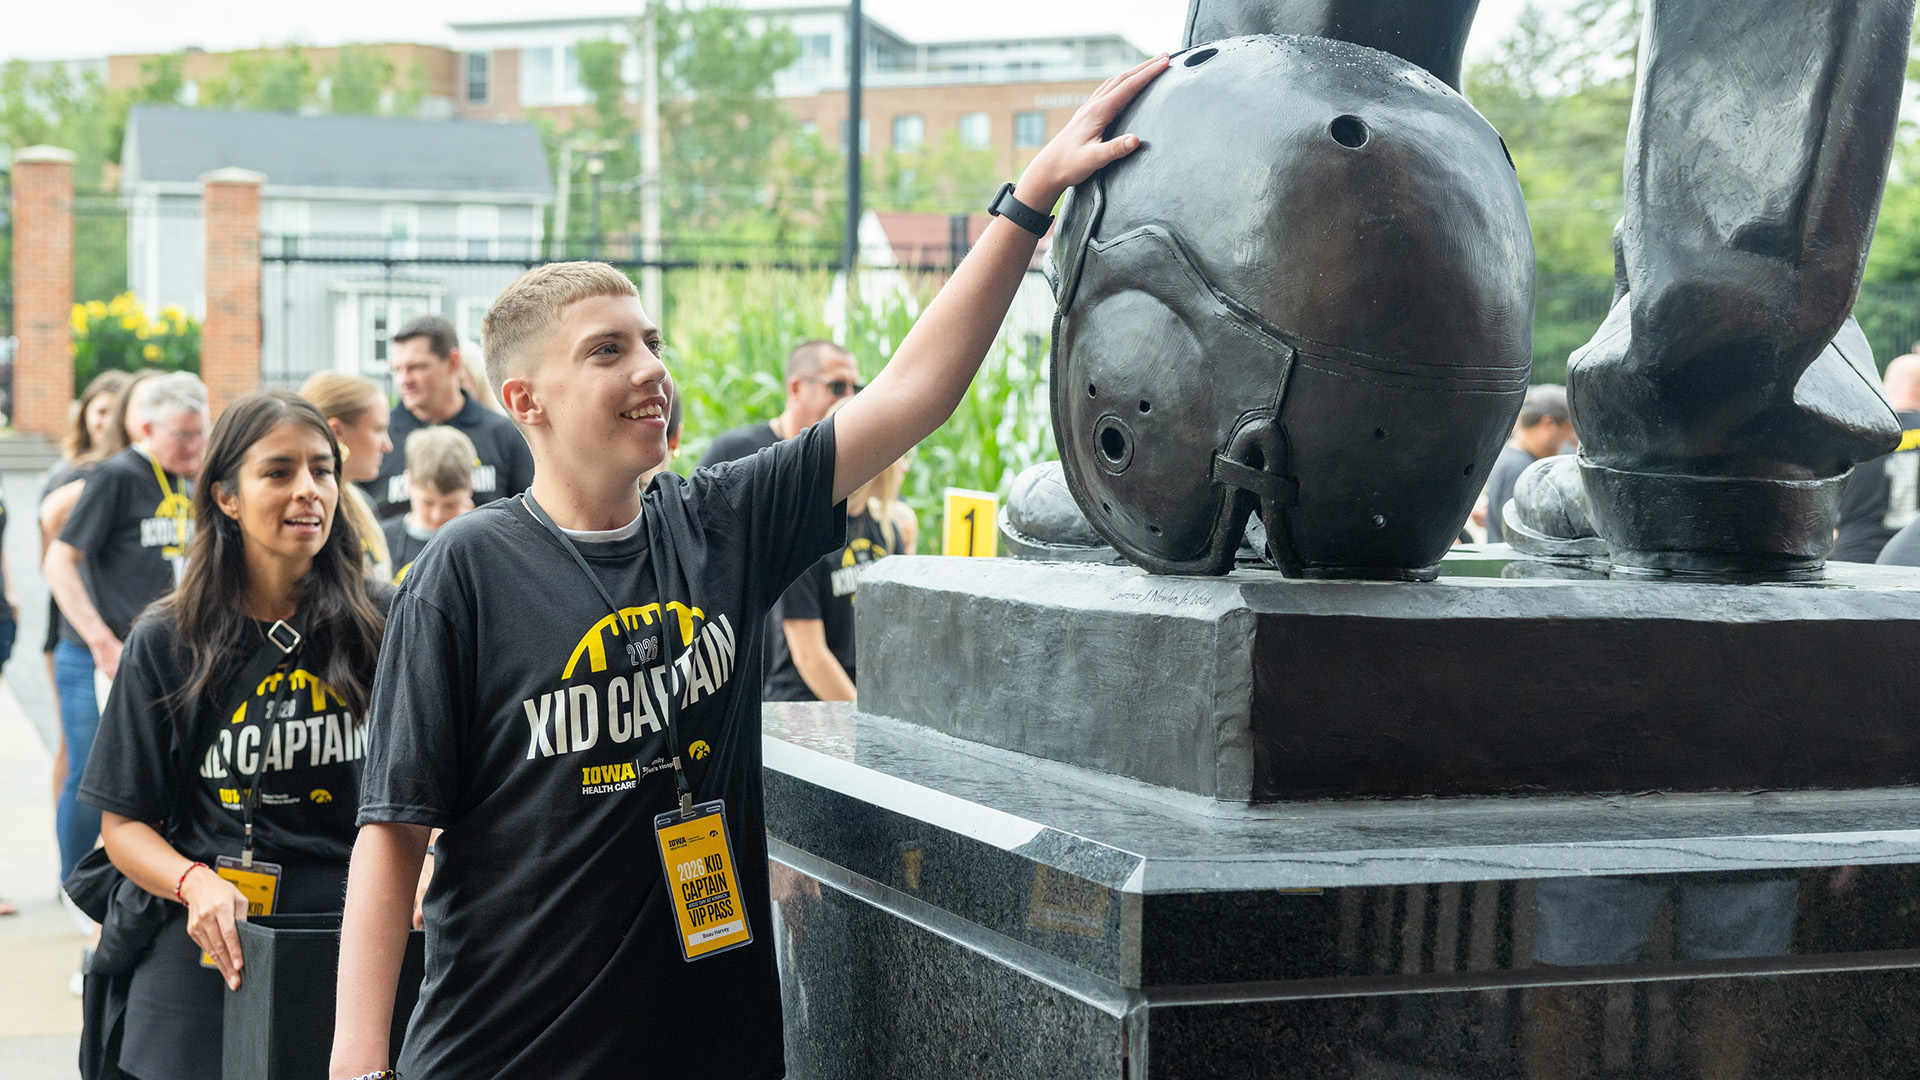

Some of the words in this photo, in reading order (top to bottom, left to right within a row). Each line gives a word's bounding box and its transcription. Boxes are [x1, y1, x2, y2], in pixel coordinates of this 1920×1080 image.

[964, 508, 976, 556] 1
[1190, 594, 1214, 606] 2006
[626, 636, 659, 666] 2026
[608, 613, 737, 744] CAPTAIN
[265, 698, 297, 719] 226
[582, 762, 637, 785] IOWA
[582, 784, 614, 795] HEALTH
[614, 780, 637, 791] CARE
[668, 837, 686, 847] IOWA
[677, 858, 705, 882] 2026
[704, 853, 723, 874] KID
[681, 872, 728, 902] CAPTAIN
[688, 907, 706, 928] VIP
[708, 899, 734, 923] PASS
